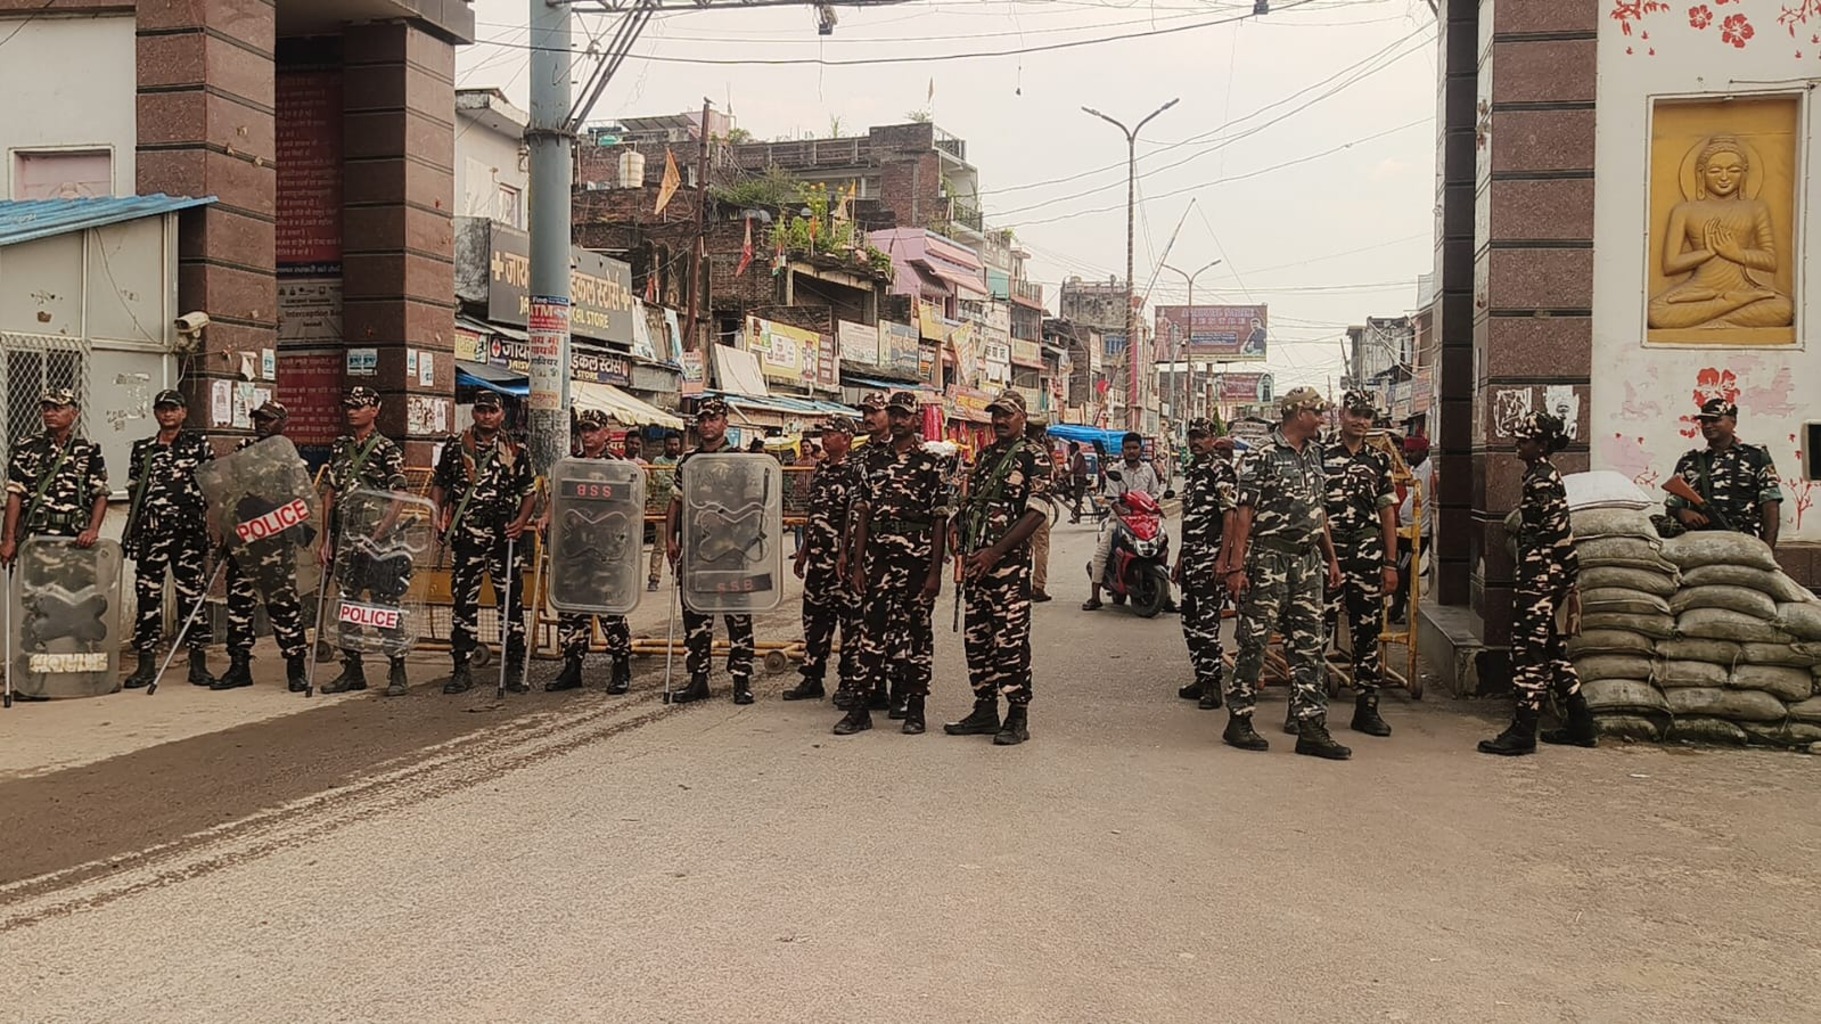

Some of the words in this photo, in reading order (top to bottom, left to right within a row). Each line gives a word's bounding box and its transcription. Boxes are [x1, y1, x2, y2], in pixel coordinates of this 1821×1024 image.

[586, 310, 609, 329] STORE
[577, 484, 612, 498] SSB
[237, 499, 309, 543] POLICE
[340, 604, 398, 628] POLICE
